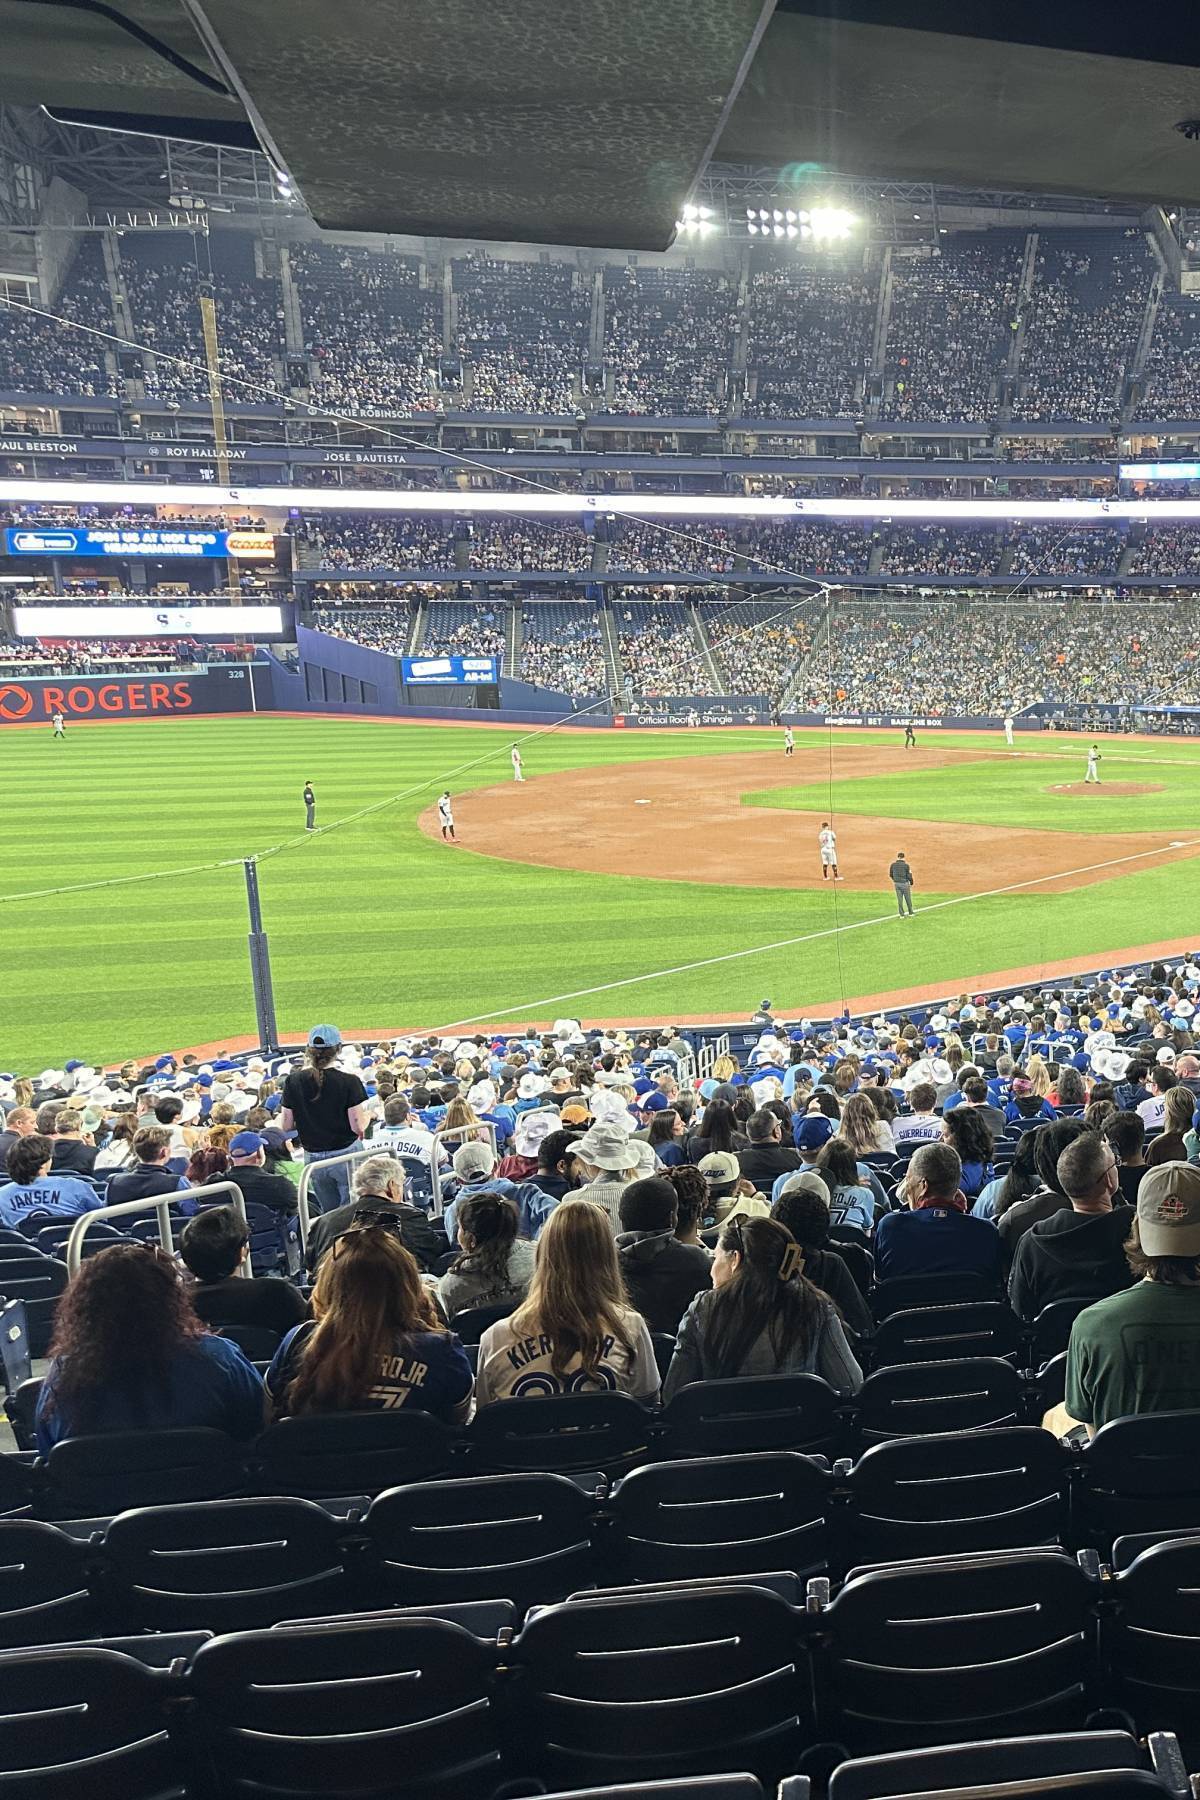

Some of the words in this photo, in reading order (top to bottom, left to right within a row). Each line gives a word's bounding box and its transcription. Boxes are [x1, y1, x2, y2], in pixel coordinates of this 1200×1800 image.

[322, 408, 358, 418] JACKIE
[360, 409, 413, 419] ROBINSON
[26, 442, 78, 453] BEESTON
[166, 447, 188, 457] ROY
[191, 448, 247, 459] HALLADAY
[355, 454, 407, 464] BAUTISTA
[86, 531, 121, 544] JOIN
[228, 670, 245, 679] 328
[43, 682, 193, 714] ROGERS
[637, 715, 668, 725] Official
[702, 715, 733, 726] Shingle
[867, 717, 882, 726] BET
[898, 1128, 933, 1140] GUERRERO
[9, 1190, 62, 1212] JANSEN
